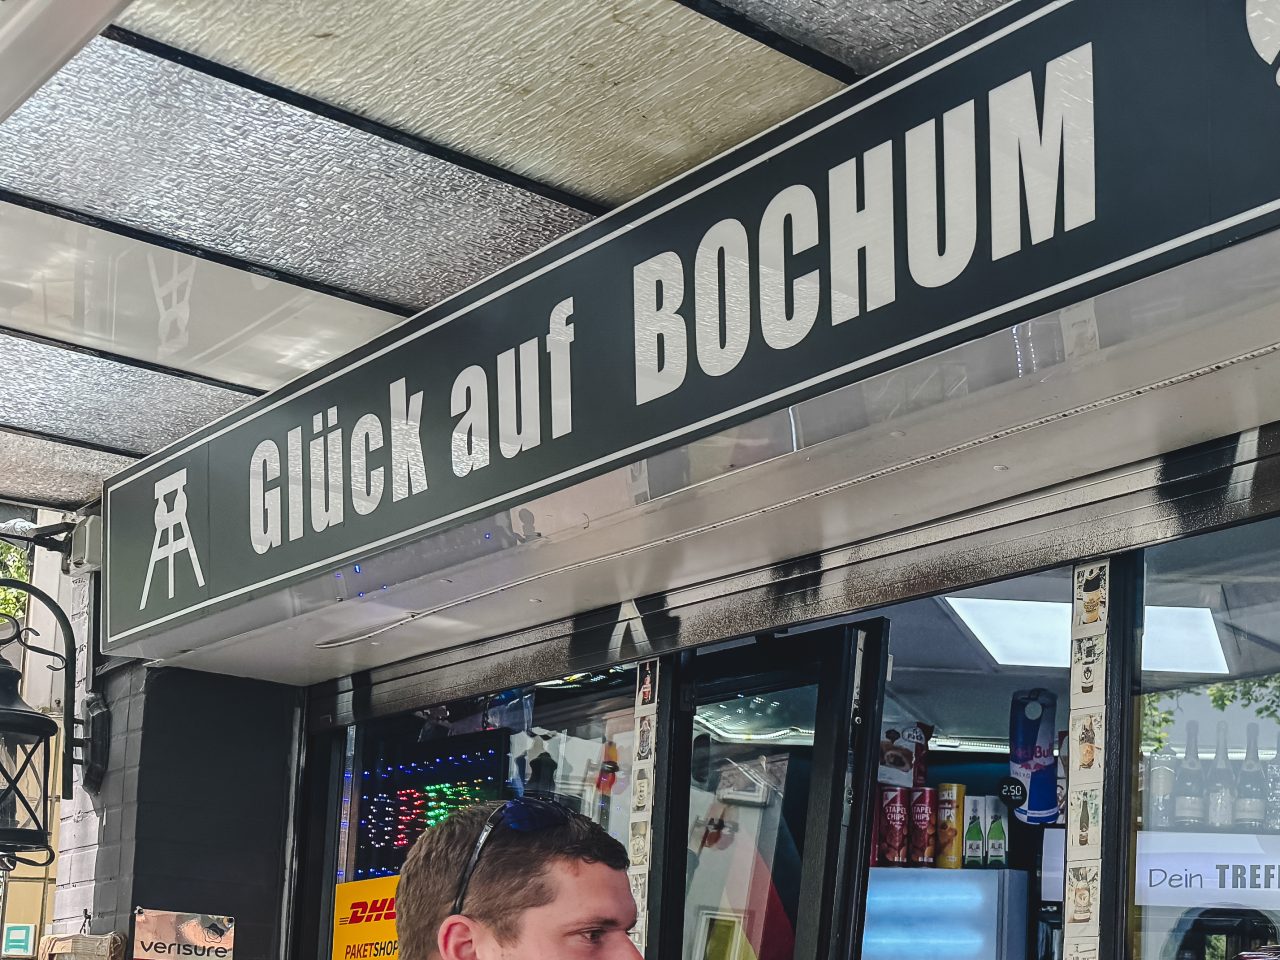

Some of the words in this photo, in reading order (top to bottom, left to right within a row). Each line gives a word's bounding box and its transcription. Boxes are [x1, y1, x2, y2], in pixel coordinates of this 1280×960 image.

[248, 375, 429, 554] Glück
[450, 296, 575, 479] auf
[633, 42, 1096, 406] BOCHUM
[1002, 785, 1022, 795] 2.50
[1148, 867, 1203, 889] Dein
[140, 940, 228, 958] verisure
[345, 942, 398, 959] PAKETSHOP
